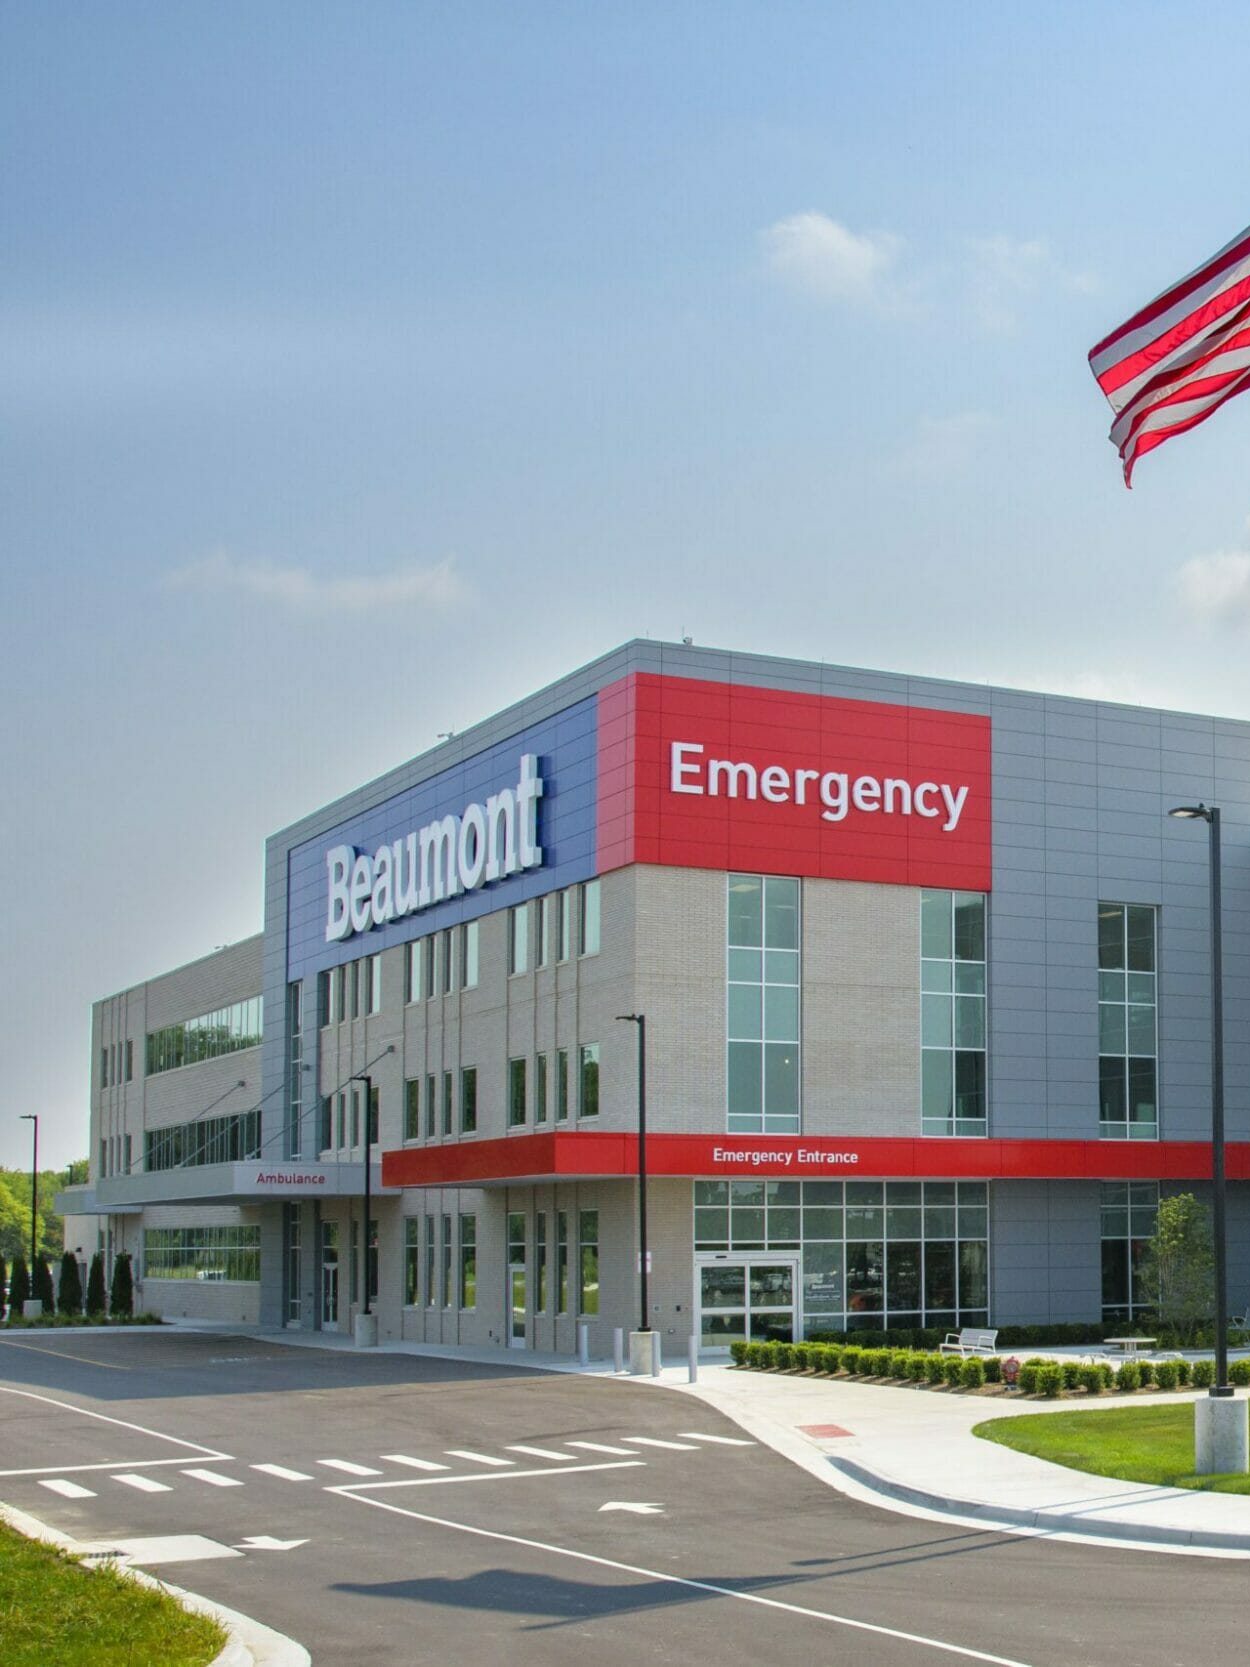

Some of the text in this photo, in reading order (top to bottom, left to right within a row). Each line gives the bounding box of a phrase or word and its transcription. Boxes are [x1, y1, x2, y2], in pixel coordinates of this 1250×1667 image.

[671, 741, 969, 831] Emergency
[325, 753, 543, 942] Beaumont
[256, 1172, 326, 1185] Ambulance
[713, 1147, 859, 1166] Emergency Entrance
